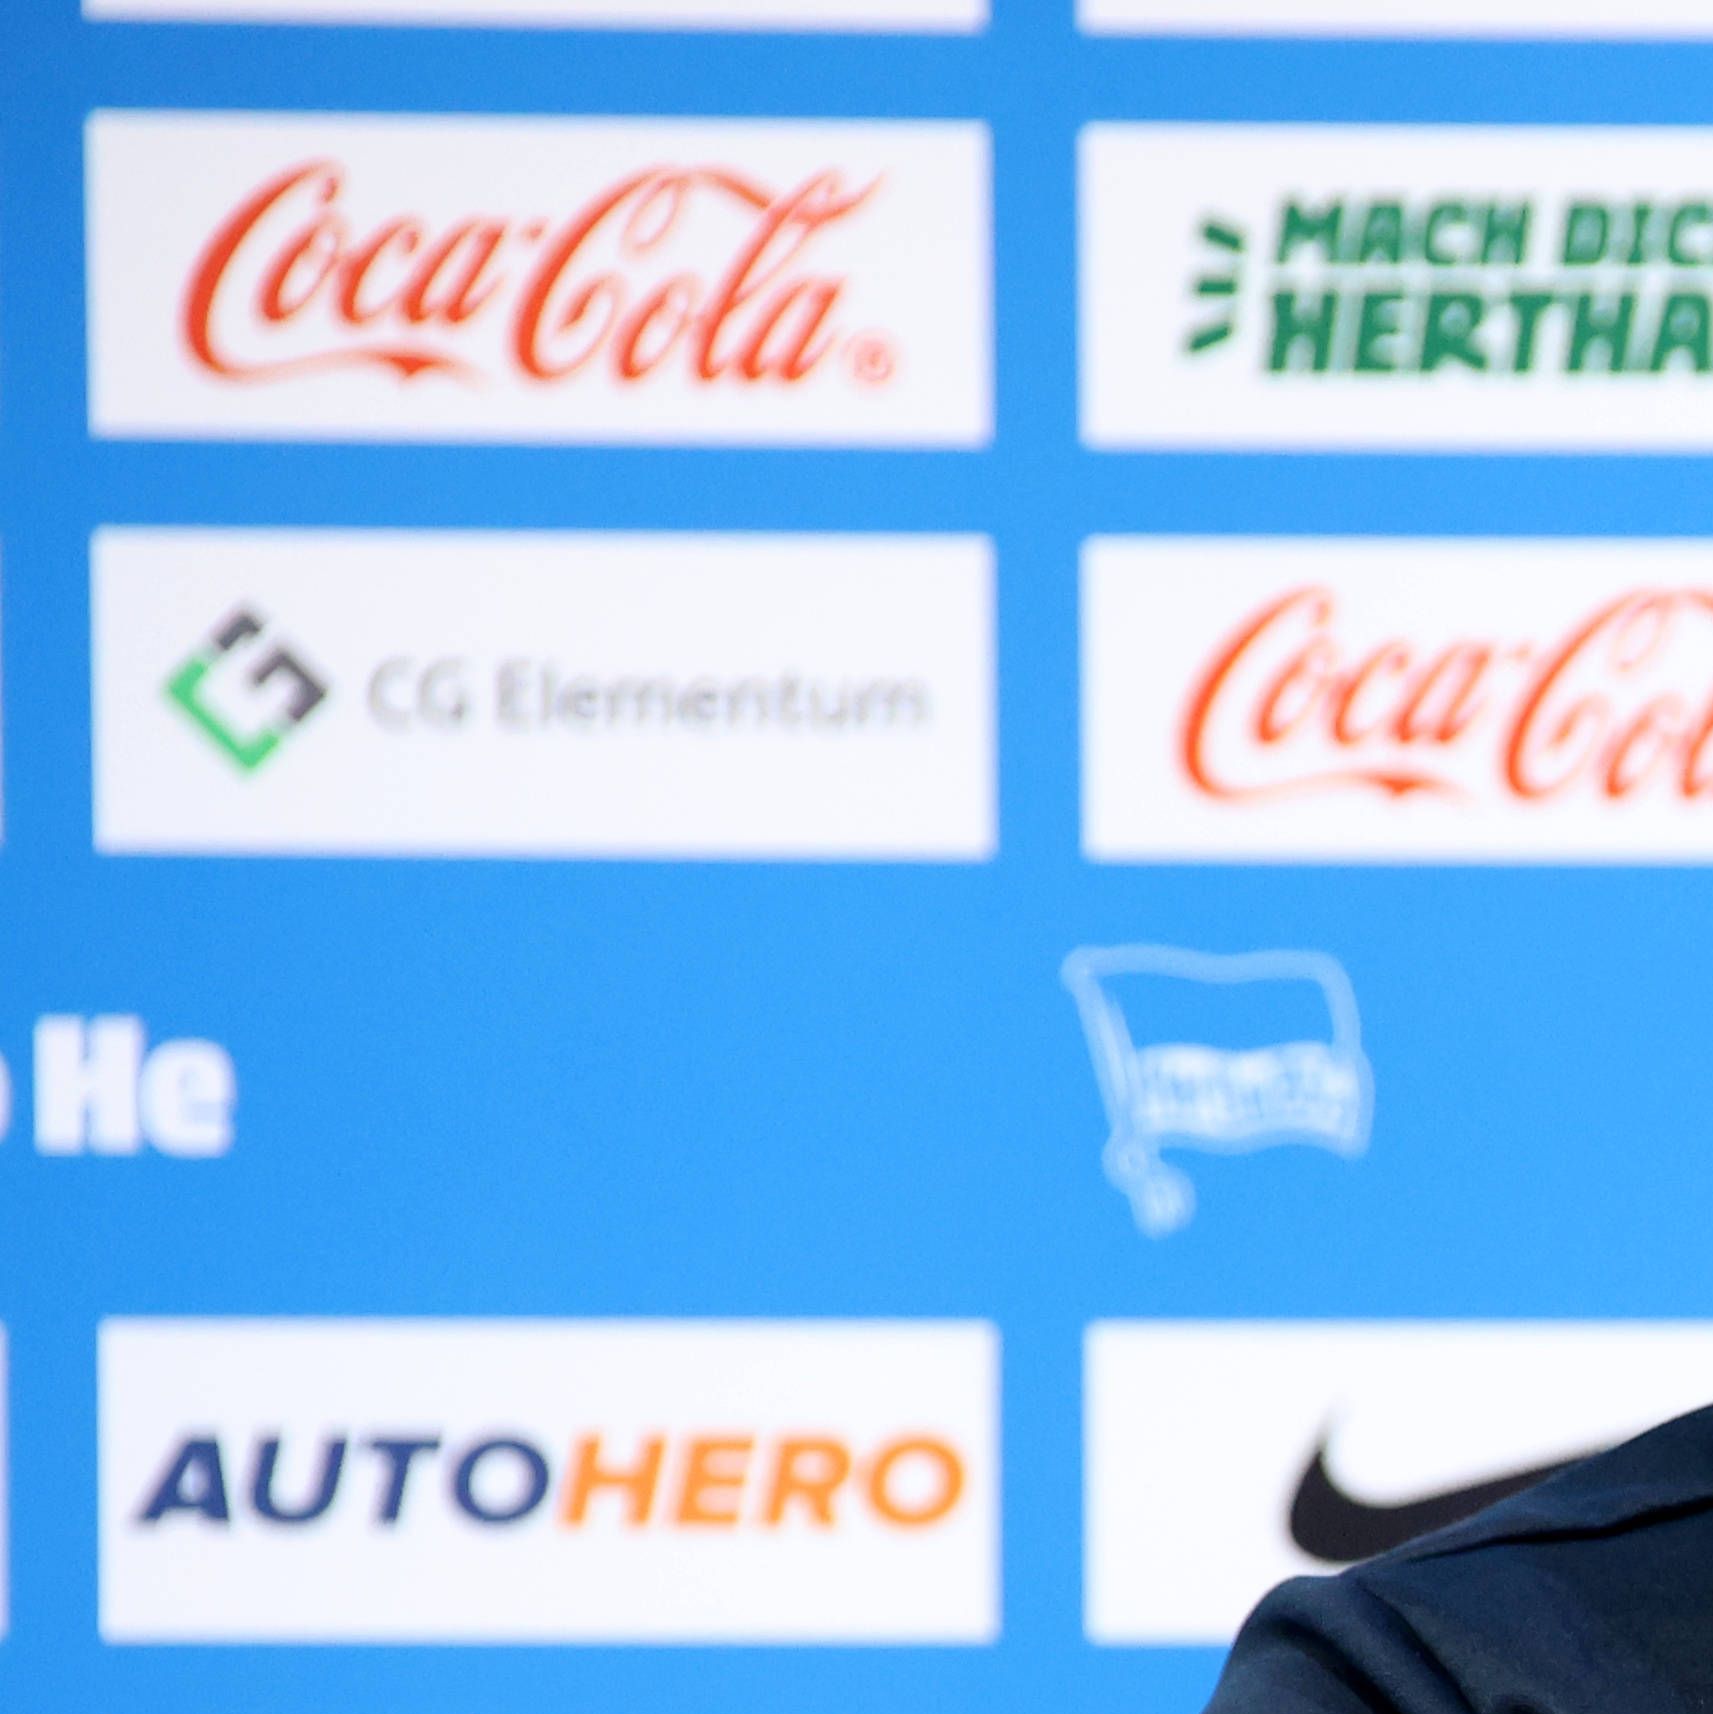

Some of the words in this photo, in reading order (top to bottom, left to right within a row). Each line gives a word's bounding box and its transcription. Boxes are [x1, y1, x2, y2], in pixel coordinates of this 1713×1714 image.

[1272, 198, 1534, 268] MACH
[364, 654, 476, 732] CG
[490, 654, 934, 735] Elementum
[33, 1013, 237, 1158] He
[135, 1431, 968, 1531] AUTOHERO
